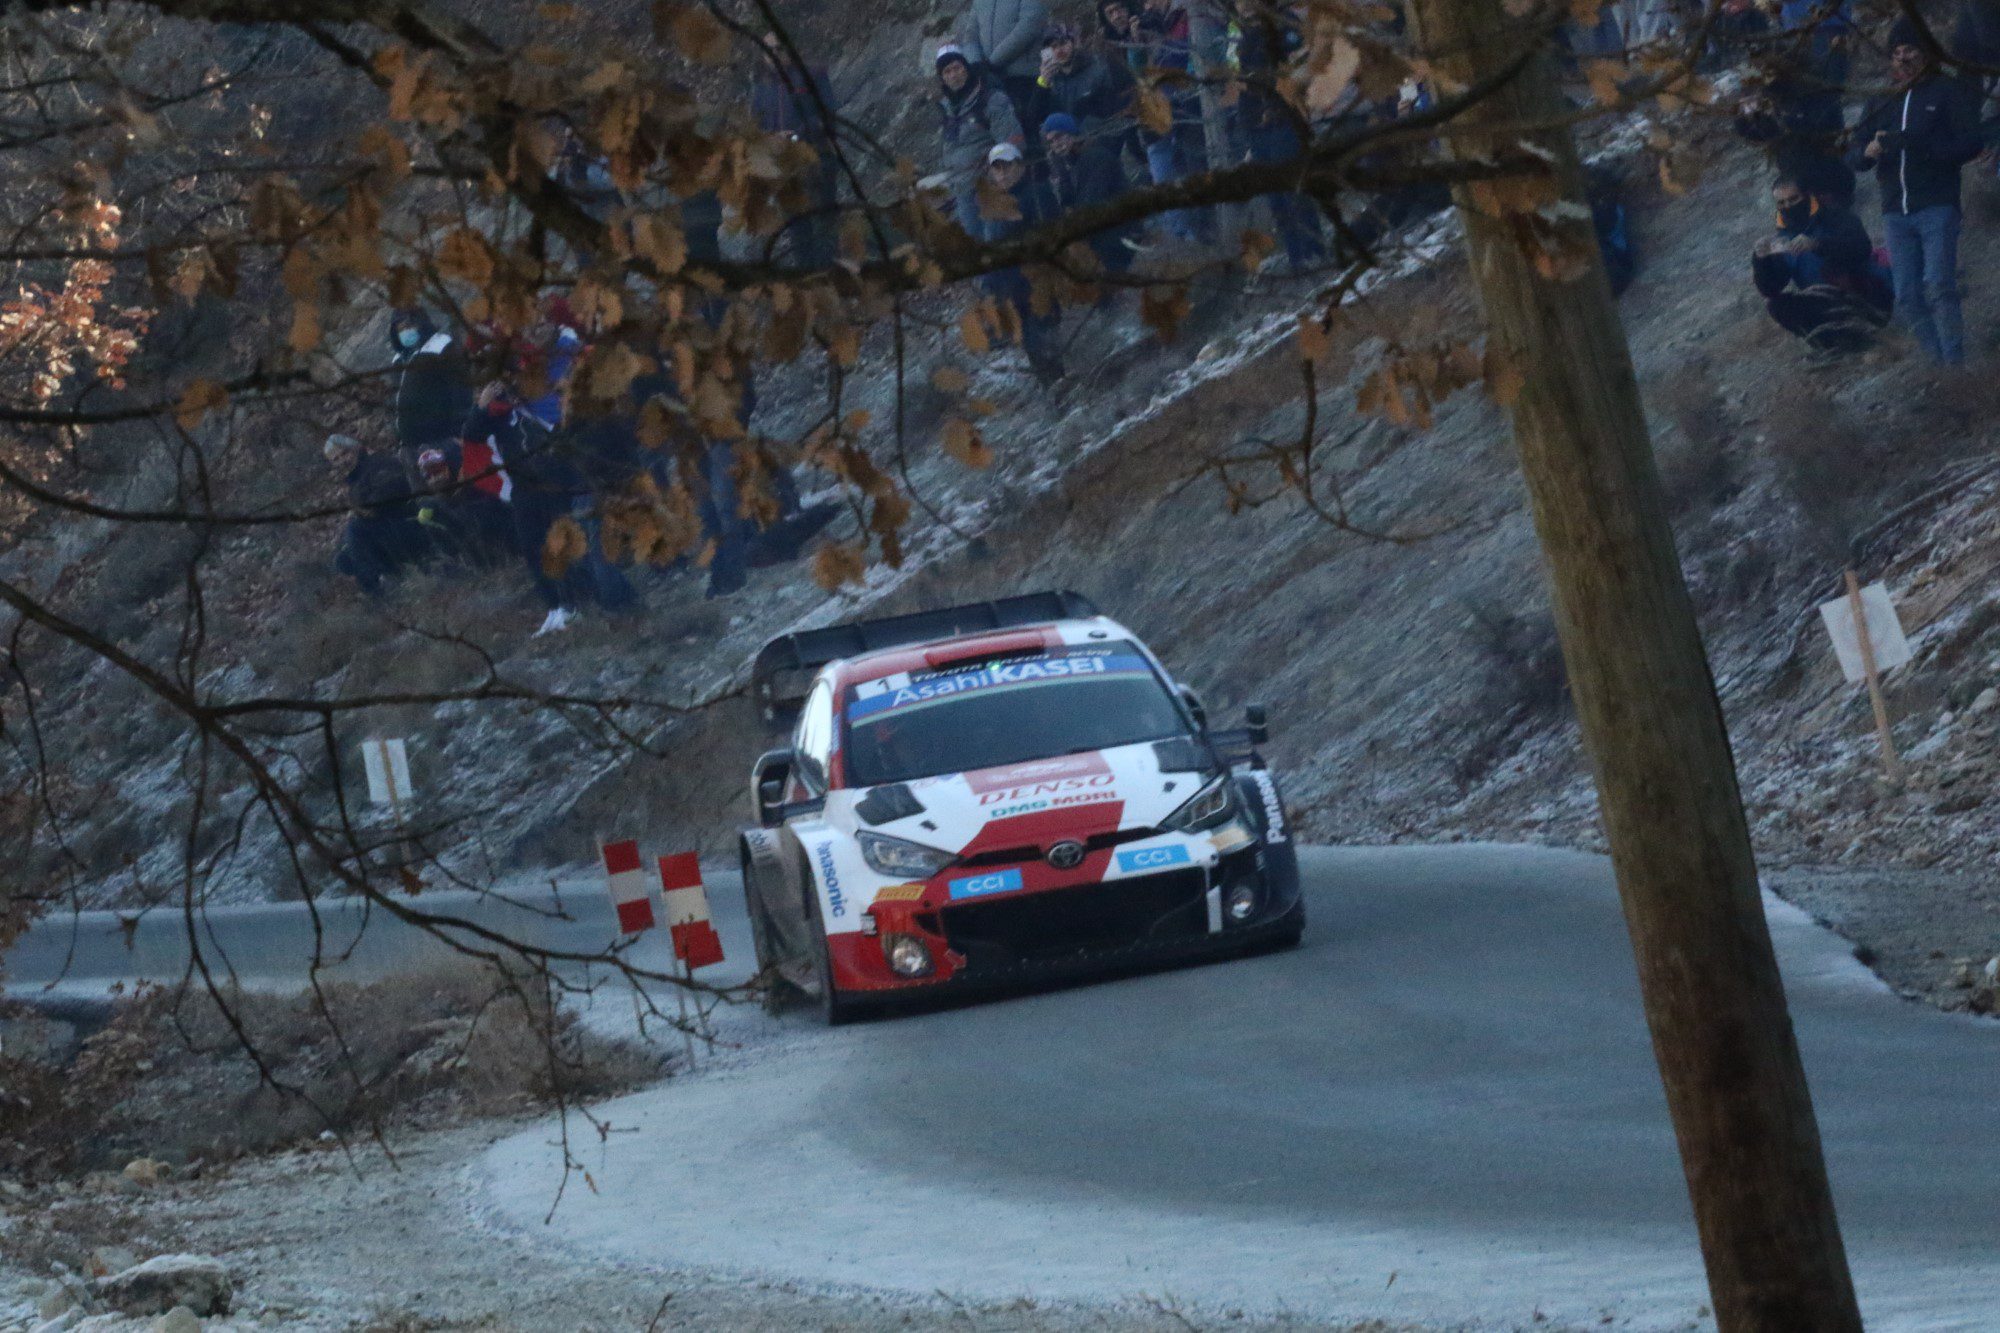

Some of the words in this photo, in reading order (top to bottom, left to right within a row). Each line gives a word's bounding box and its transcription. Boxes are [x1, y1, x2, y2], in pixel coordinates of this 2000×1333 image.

[892, 669, 989, 706] Asahi
[990, 656, 1106, 685] KASEI
[979, 775, 1115, 806] DENSO
[990, 801, 1048, 818] DMG
[1051, 790, 1117, 806] MORI
[1251, 769, 1288, 844] Panaso
